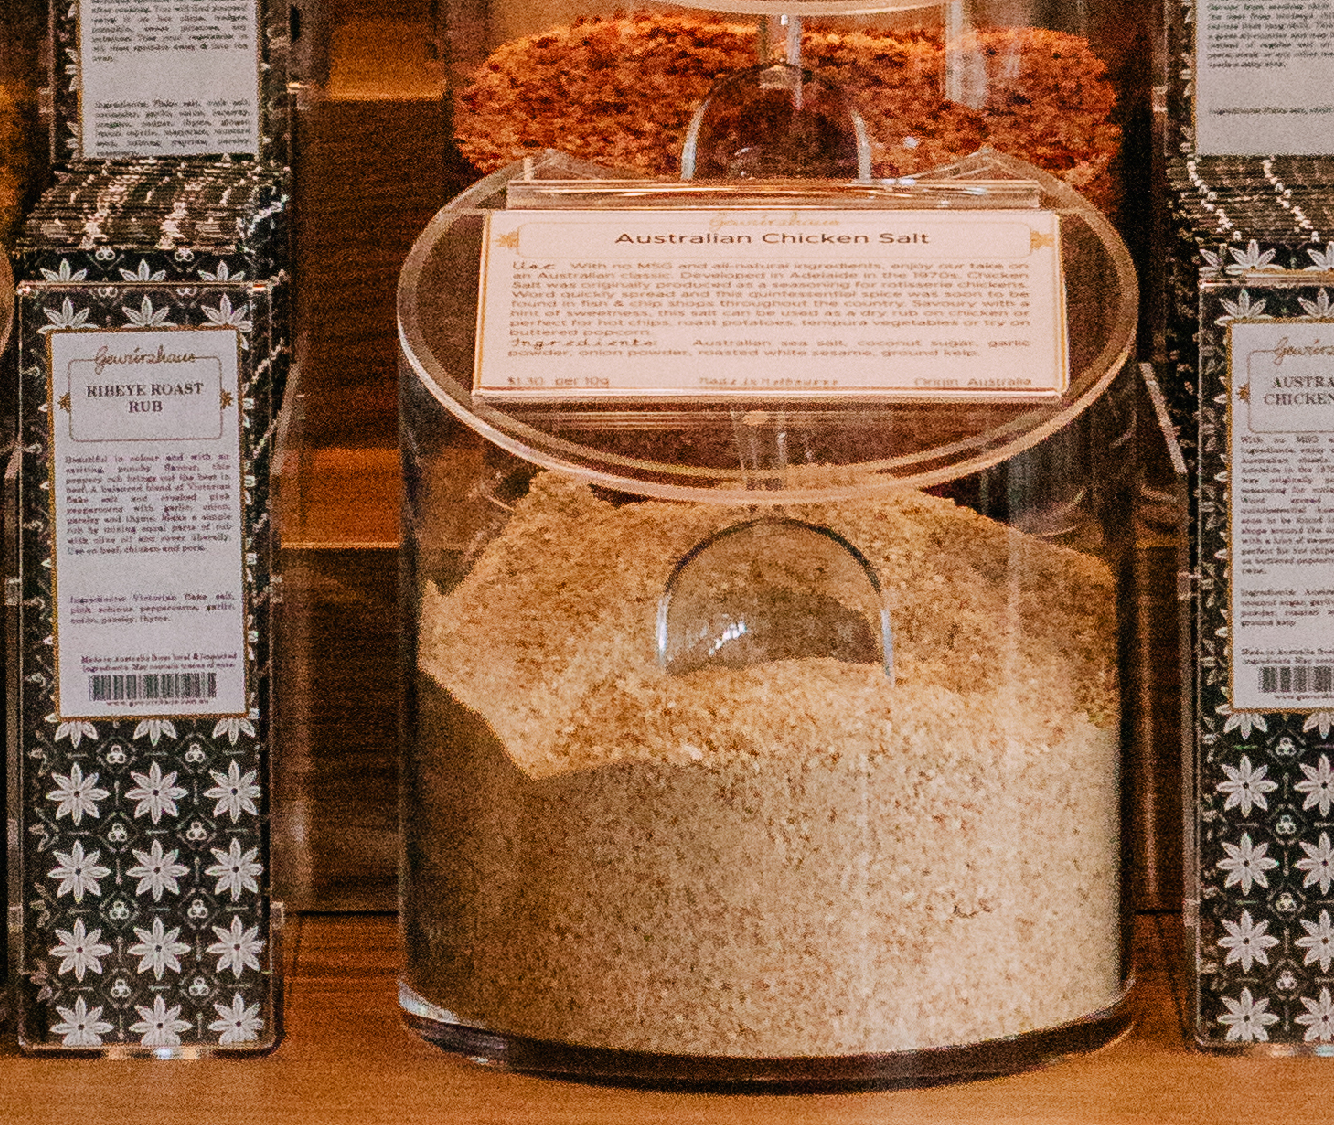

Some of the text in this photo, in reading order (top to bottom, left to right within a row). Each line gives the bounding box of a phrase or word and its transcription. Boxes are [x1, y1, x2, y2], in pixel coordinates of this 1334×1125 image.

[615, 233, 930, 244] Australian Chicken Salt
[680, 272, 765, 280] Developed
[561, 291, 615, 299] quickly
[622, 291, 676, 299] spread
[862, 291, 902, 299] spice
[86, 382, 205, 398] RIBEYE ROAST
[128, 400, 164, 413] RUB
